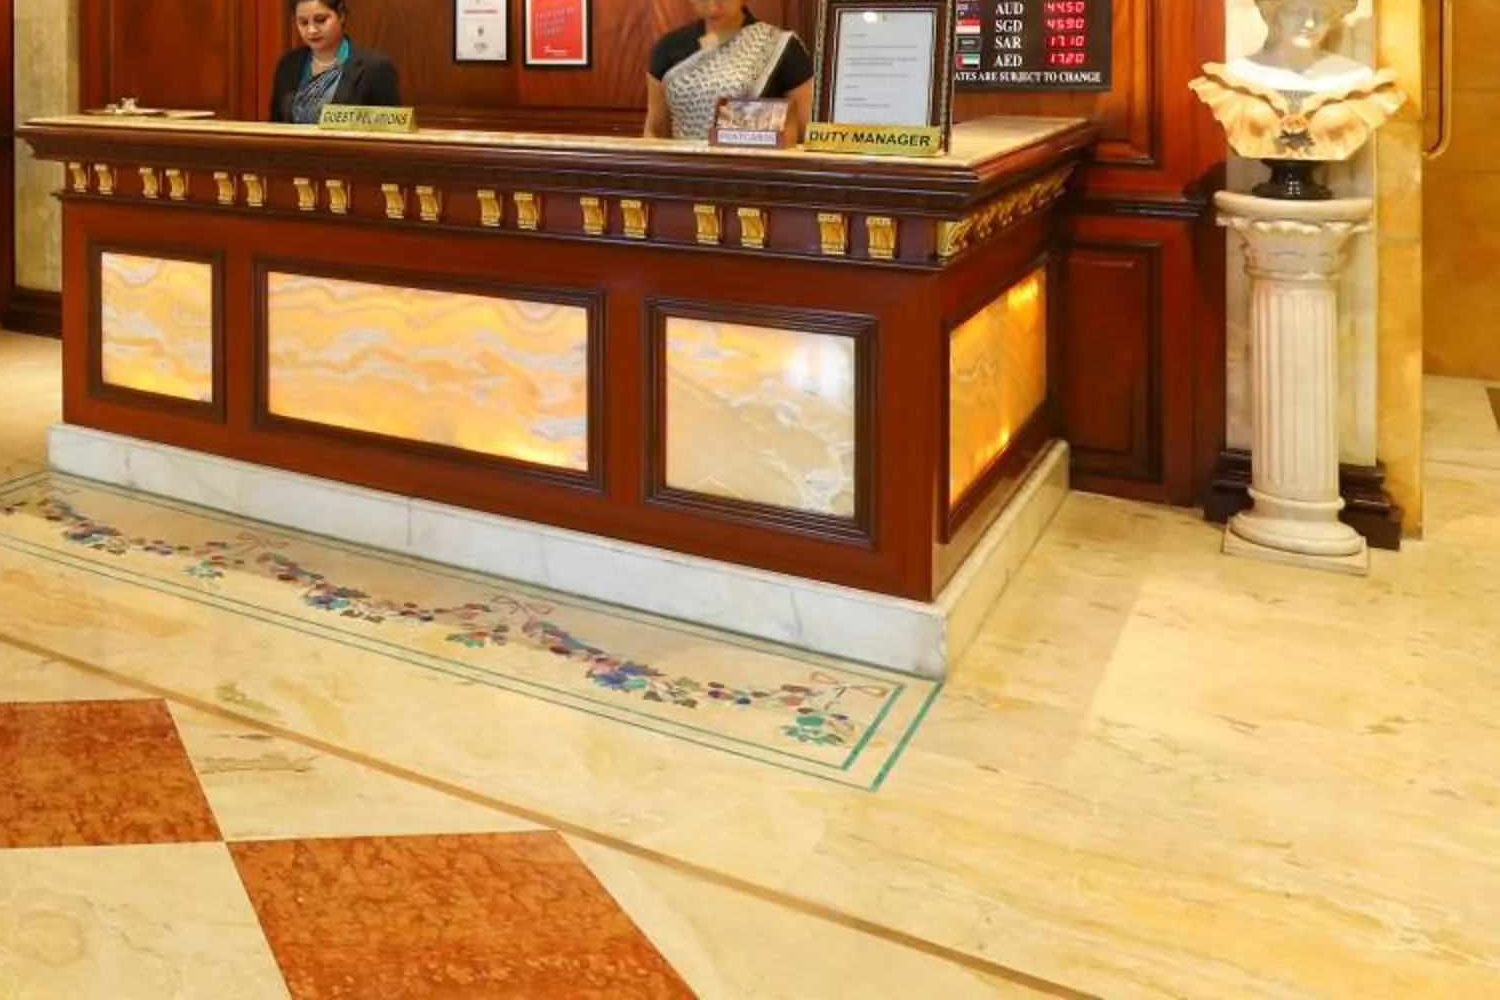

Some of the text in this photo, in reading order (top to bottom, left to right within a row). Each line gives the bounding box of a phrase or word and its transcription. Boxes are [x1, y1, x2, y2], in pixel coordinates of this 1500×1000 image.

[995, 2, 1024, 15] AUD
[995, 19, 1023, 33] SGD
[995, 35, 1021, 49] SAR
[994, 53, 1023, 67] AED
[953, 71, 1101, 83] ATES ARE SUBJECT TO CHANGE
[809, 130, 932, 147] DUTY MANAGER
